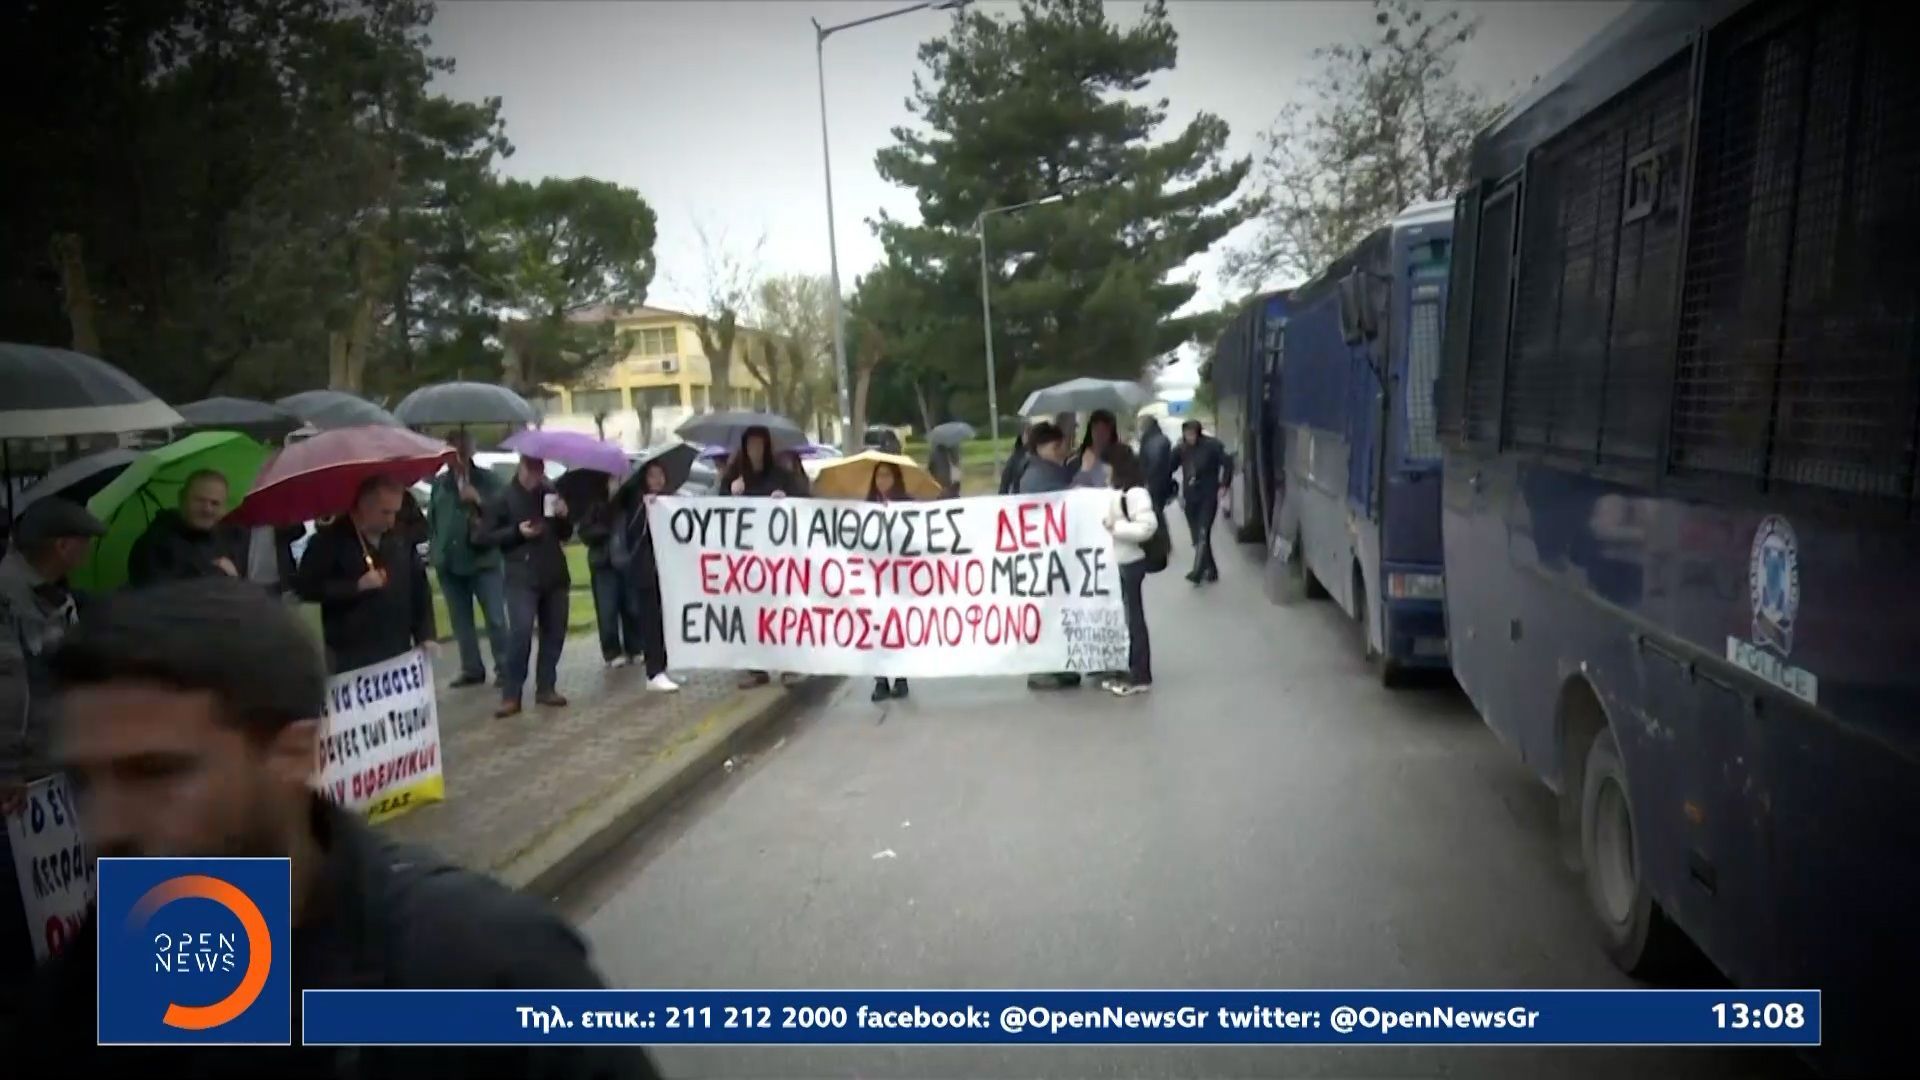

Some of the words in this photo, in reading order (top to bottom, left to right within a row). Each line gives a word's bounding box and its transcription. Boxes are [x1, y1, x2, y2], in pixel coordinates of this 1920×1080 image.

[670, 506, 755, 550] ΟΥΤΕ
[768, 508, 798, 547] ΟΙ
[807, 507, 973, 556] ΑΙΘΟΥΣΕΣ
[994, 501, 1068, 553] ΔΕΝ
[699, 553, 811, 596] ΕΧΟΥΝ
[821, 556, 985, 598] ΟΞΥΓΟΝΟ
[991, 552, 1071, 599] ΜΕΣΑ
[1079, 547, 1110, 597] ΣΕ
[681, 602, 747, 644] ΕΝΑ
[1735, 641, 1808, 697] POLICE
